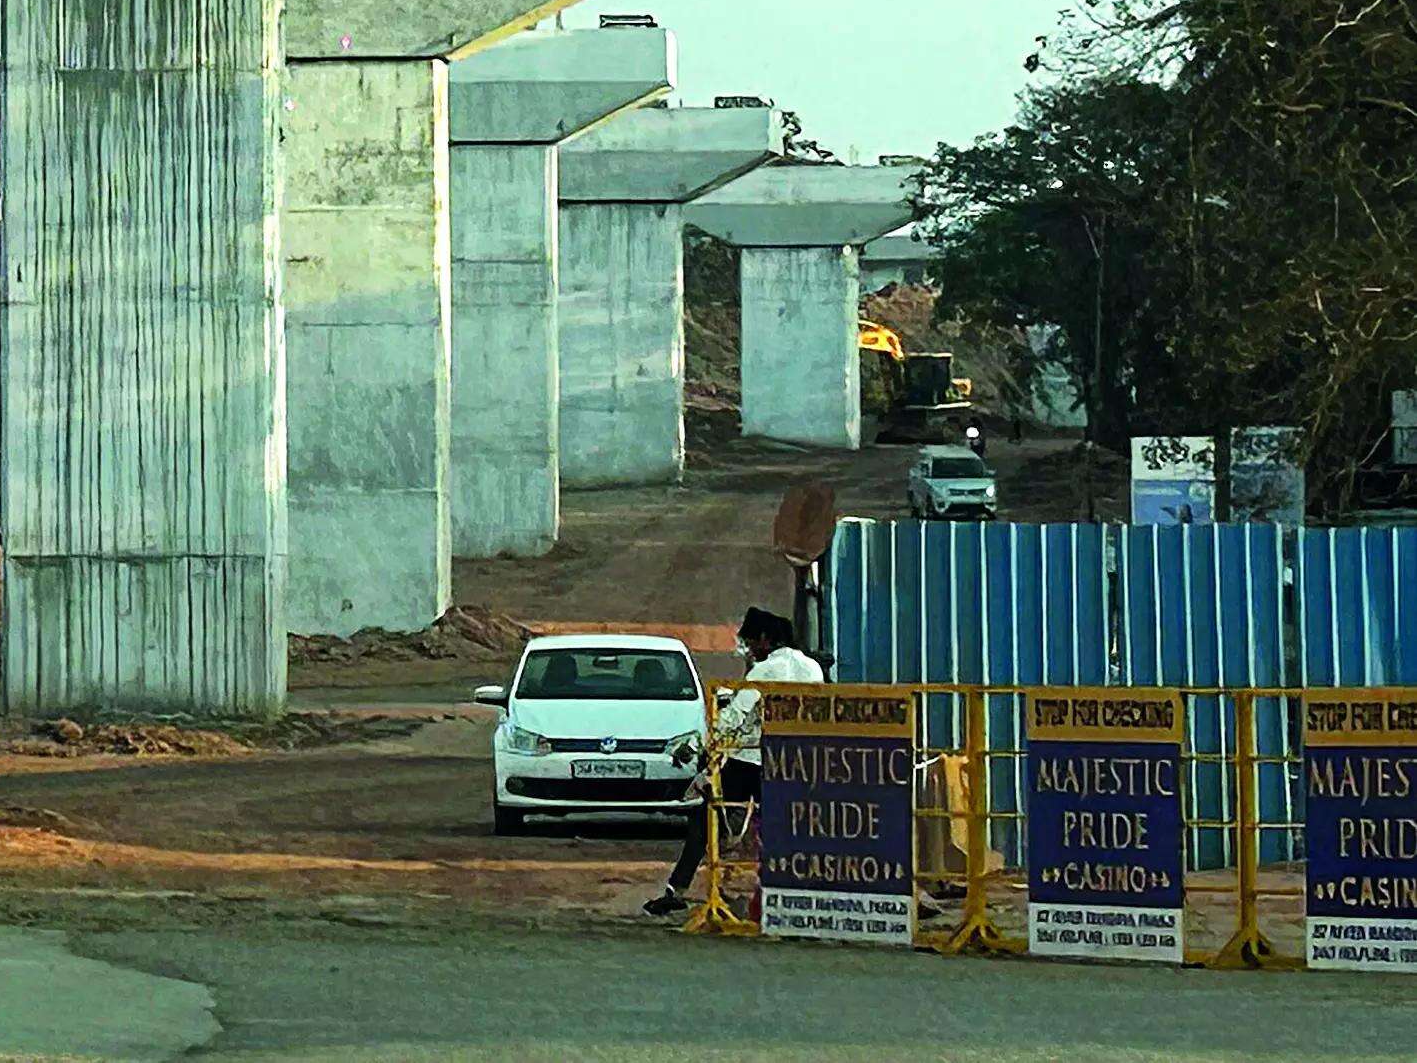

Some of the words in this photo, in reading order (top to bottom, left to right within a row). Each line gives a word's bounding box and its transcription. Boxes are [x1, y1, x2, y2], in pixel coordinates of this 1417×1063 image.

[764, 745, 910, 787] MAJESTIC
[1037, 757, 1175, 799] MAJESTIC
[1309, 756, 1417, 806] MAJES
[791, 801, 880, 839] PRIDE
[1063, 811, 1150, 850] PRIDE
[791, 852, 879, 883] CASINO
[1063, 861, 1147, 893] CASINO
